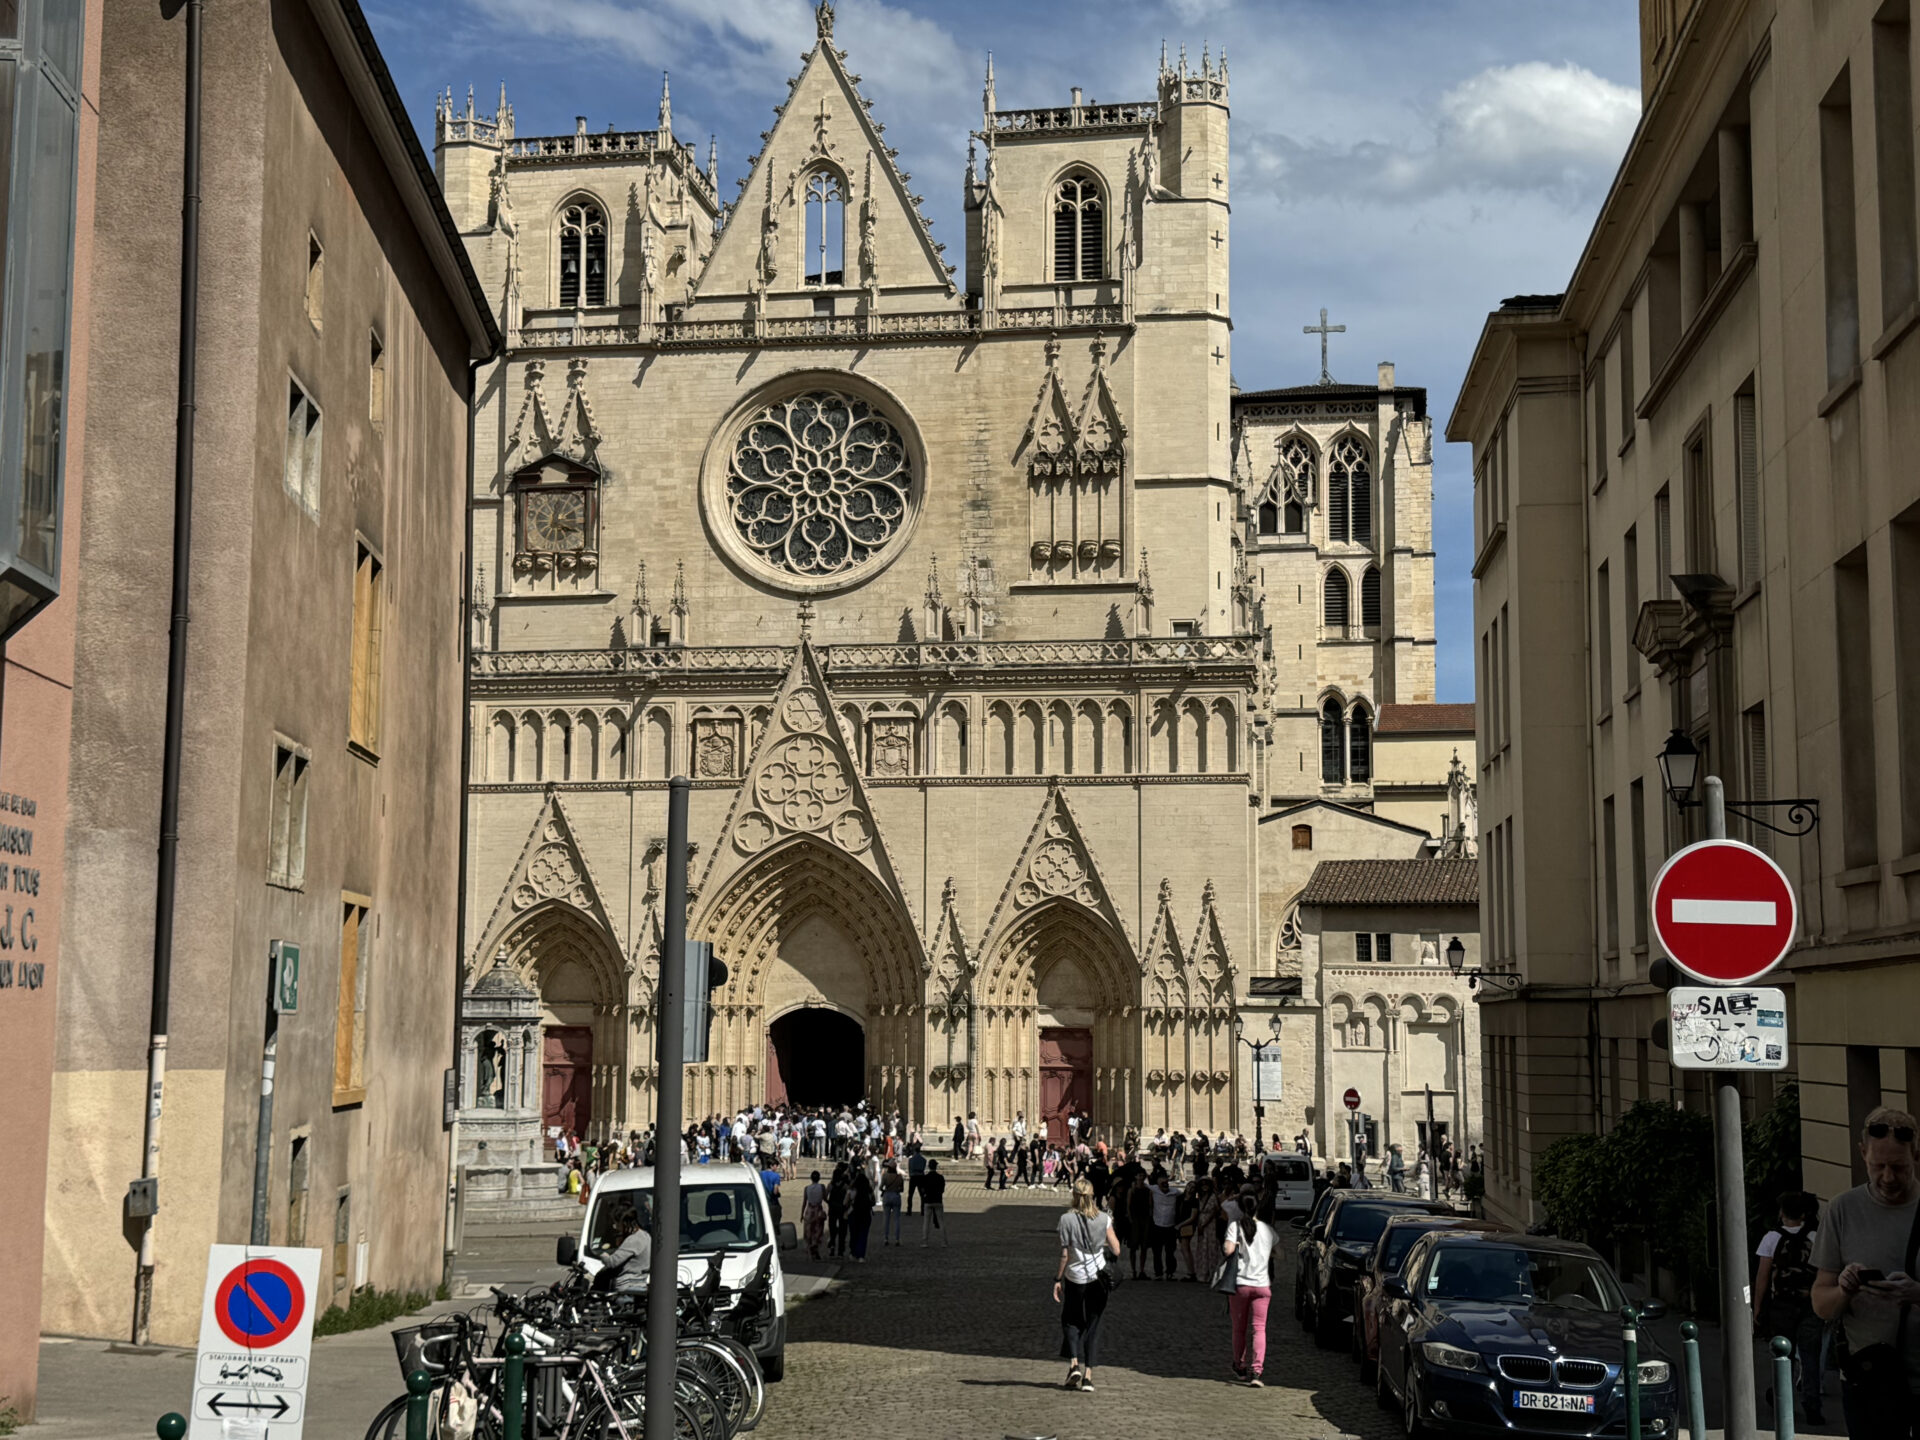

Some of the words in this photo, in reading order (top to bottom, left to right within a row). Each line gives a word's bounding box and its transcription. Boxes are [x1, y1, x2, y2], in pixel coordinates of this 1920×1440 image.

[13, 864, 40, 898] TOUS
[18, 962, 45, 991] LYON
[1698, 995, 1759, 1015] SAF
